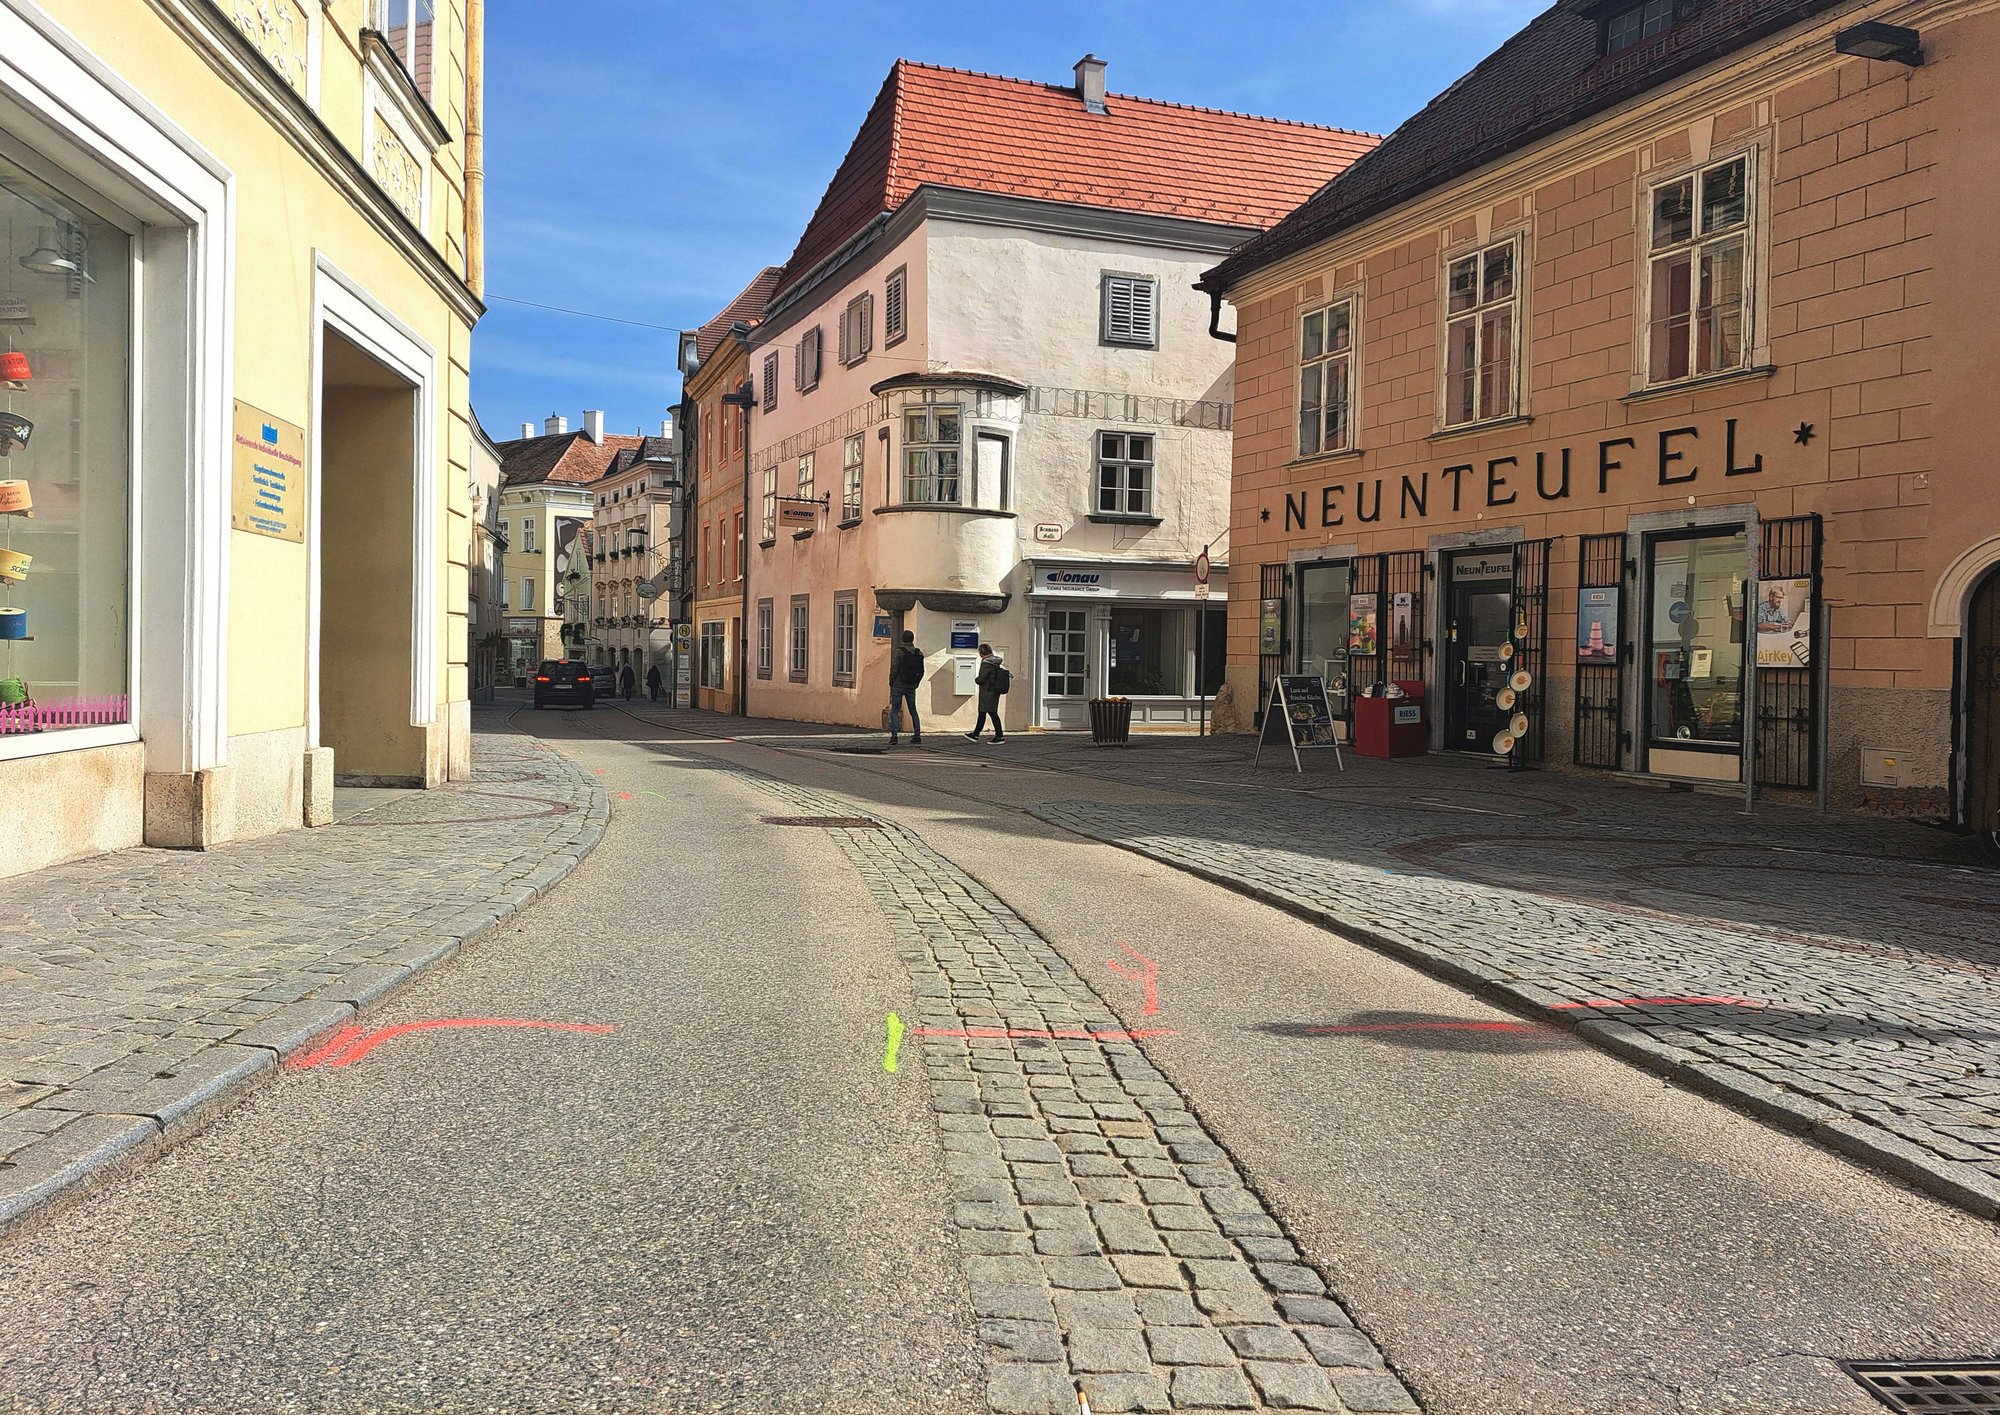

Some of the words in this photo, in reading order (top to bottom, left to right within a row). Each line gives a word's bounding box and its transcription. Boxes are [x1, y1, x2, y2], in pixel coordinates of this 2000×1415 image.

[1285, 419, 1762, 532] NEUNTEUFEL
[1757, 649, 1793, 665] AirKey
[1399, 709, 1416, 718] RIESS
